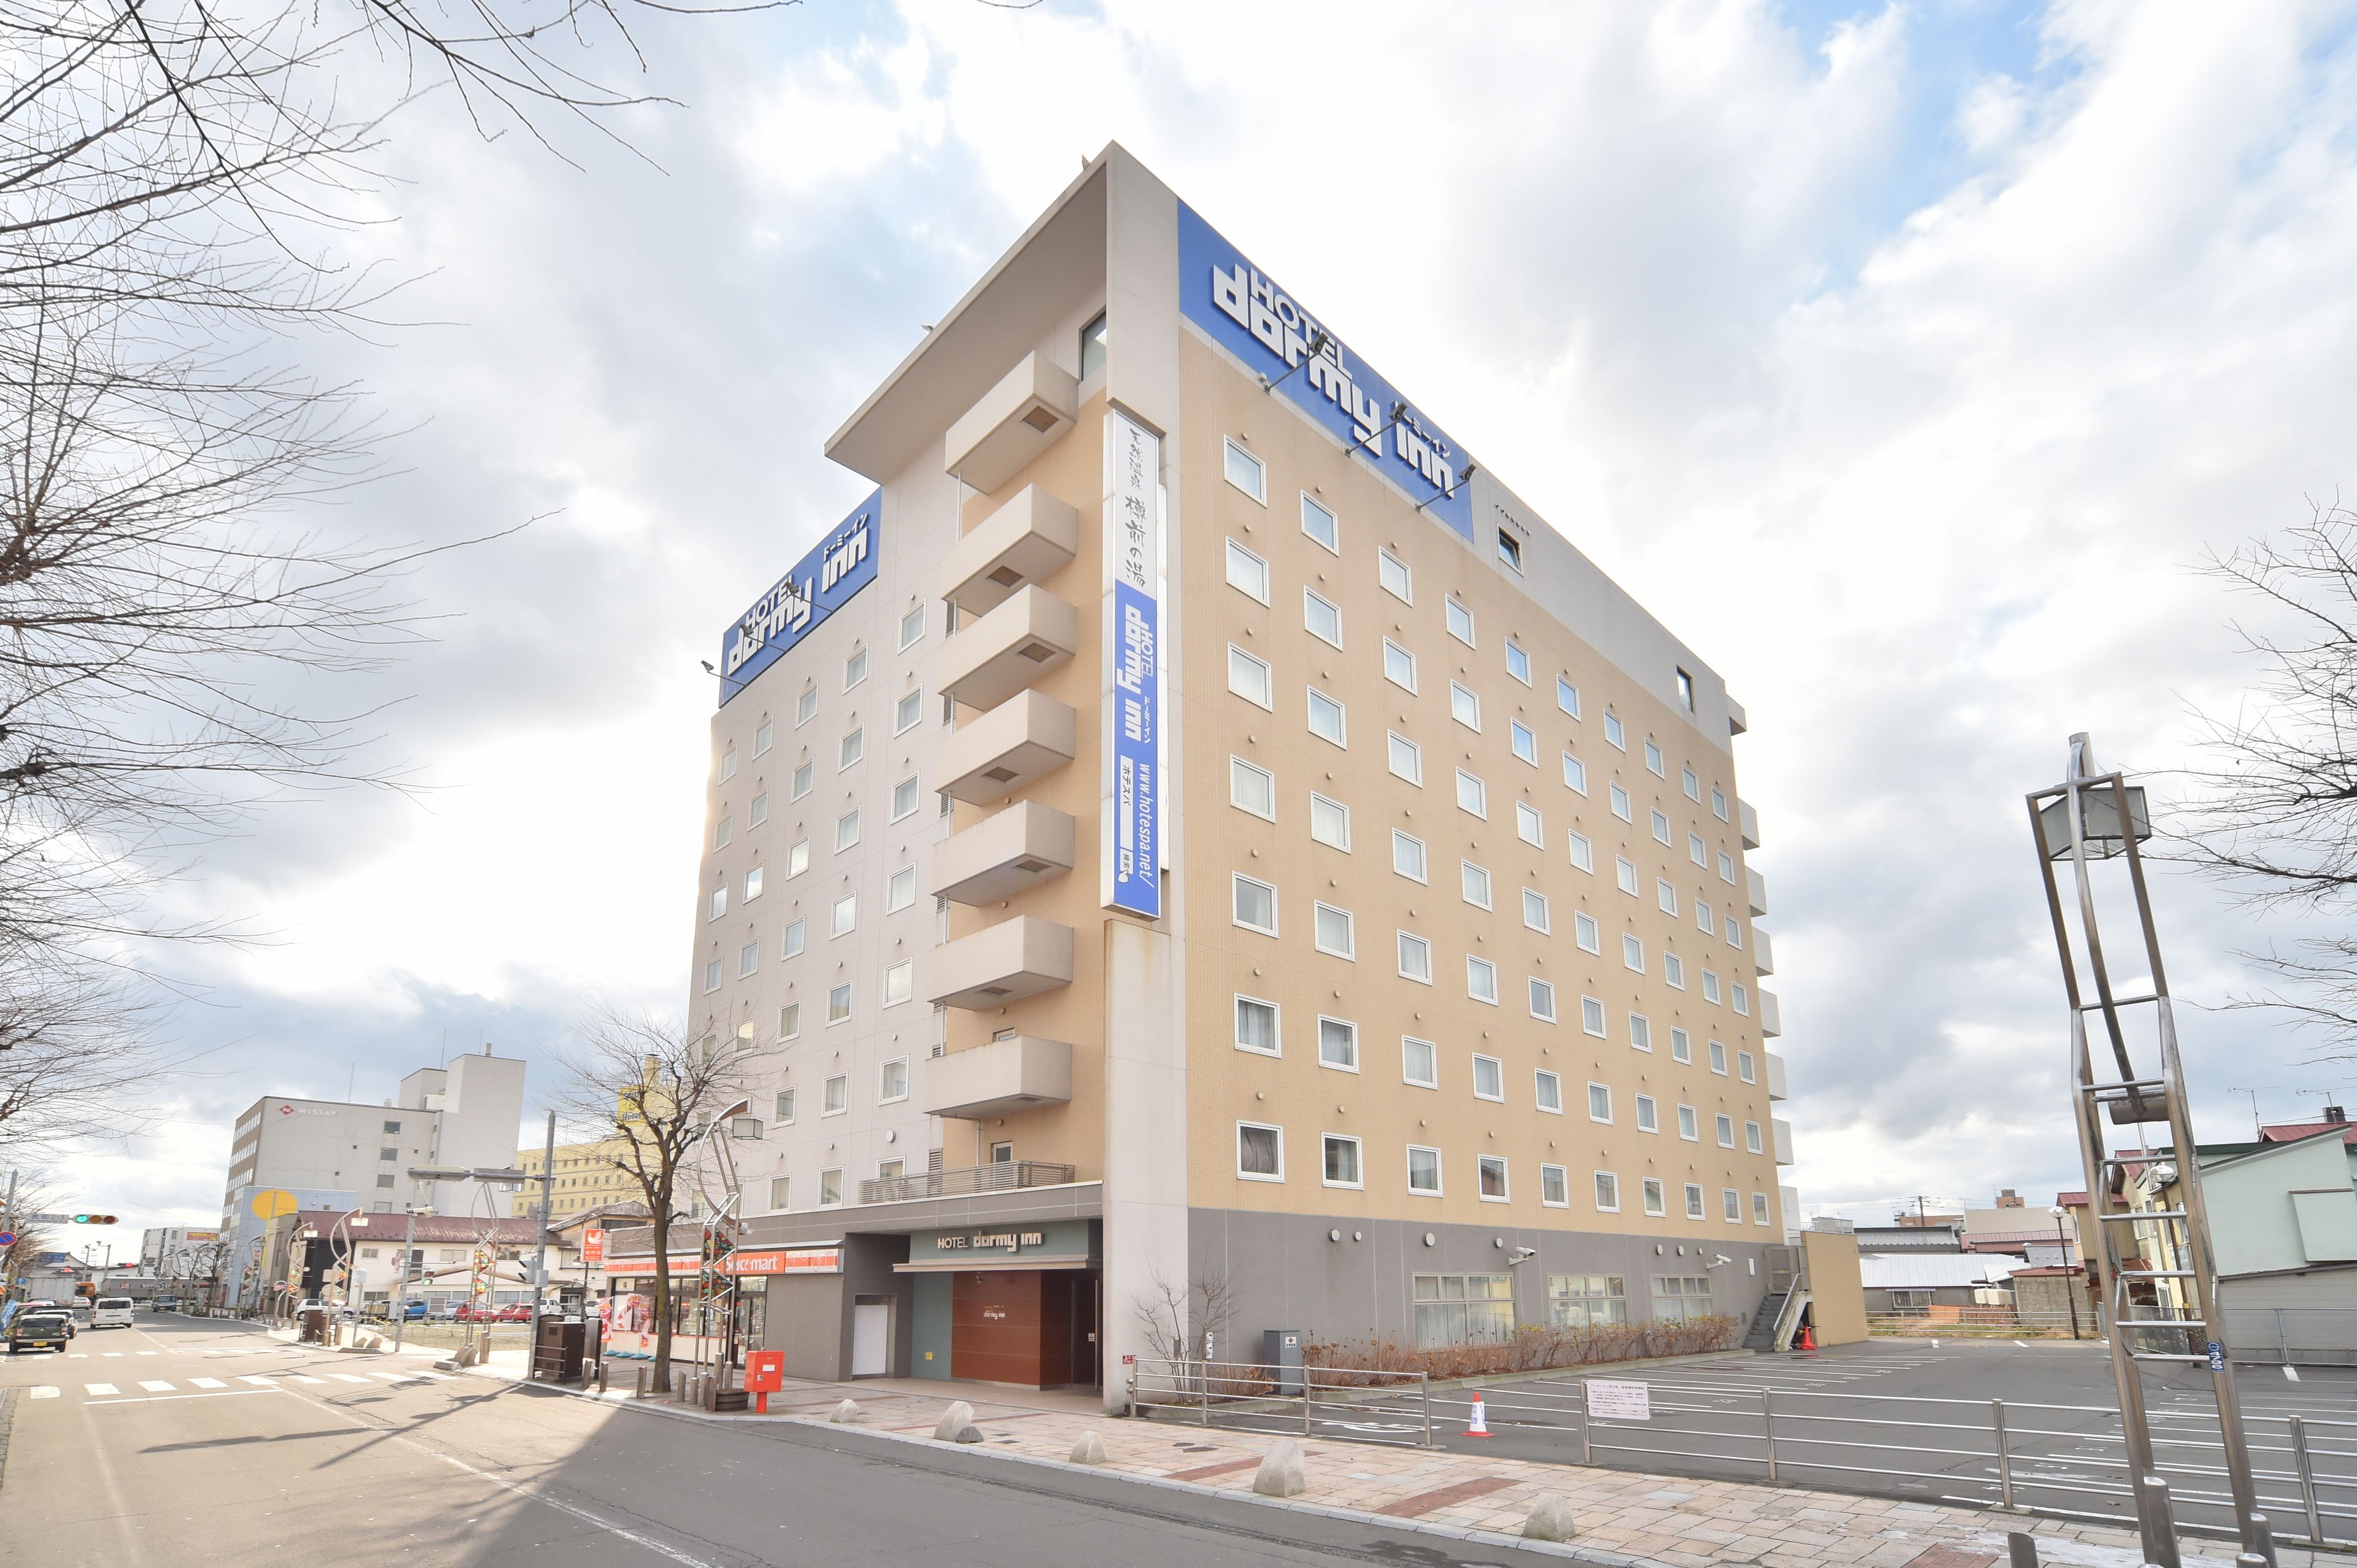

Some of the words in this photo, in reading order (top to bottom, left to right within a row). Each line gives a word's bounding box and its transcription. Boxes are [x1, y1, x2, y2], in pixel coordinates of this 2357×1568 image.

[1250, 267, 1352, 380] HOTEL
[1213, 264, 1382, 458] dormy
[1396, 422, 1453, 499] inn
[1395, 401, 1450, 457] ーミーイン
[1129, 428, 1143, 491] 天然温泉
[823, 513, 869, 562] ドーミーイン
[1125, 495, 1146, 587] 樽前の湯
[728, 577, 813, 676] dormy
[822, 527, 867, 593] inn
[1117, 604, 1149, 695] dormy
[1141, 629, 1153, 679] HOTEL
[1125, 698, 1141, 742] inn
[1122, 765, 1131, 806] ホテスパ
[1139, 763, 1155, 888] www.hotespa.net/
[937, 1236, 969, 1249] HOTEL
[973, 1230, 1018, 1252] dormy
[1021, 1232, 1042, 1245] inn
